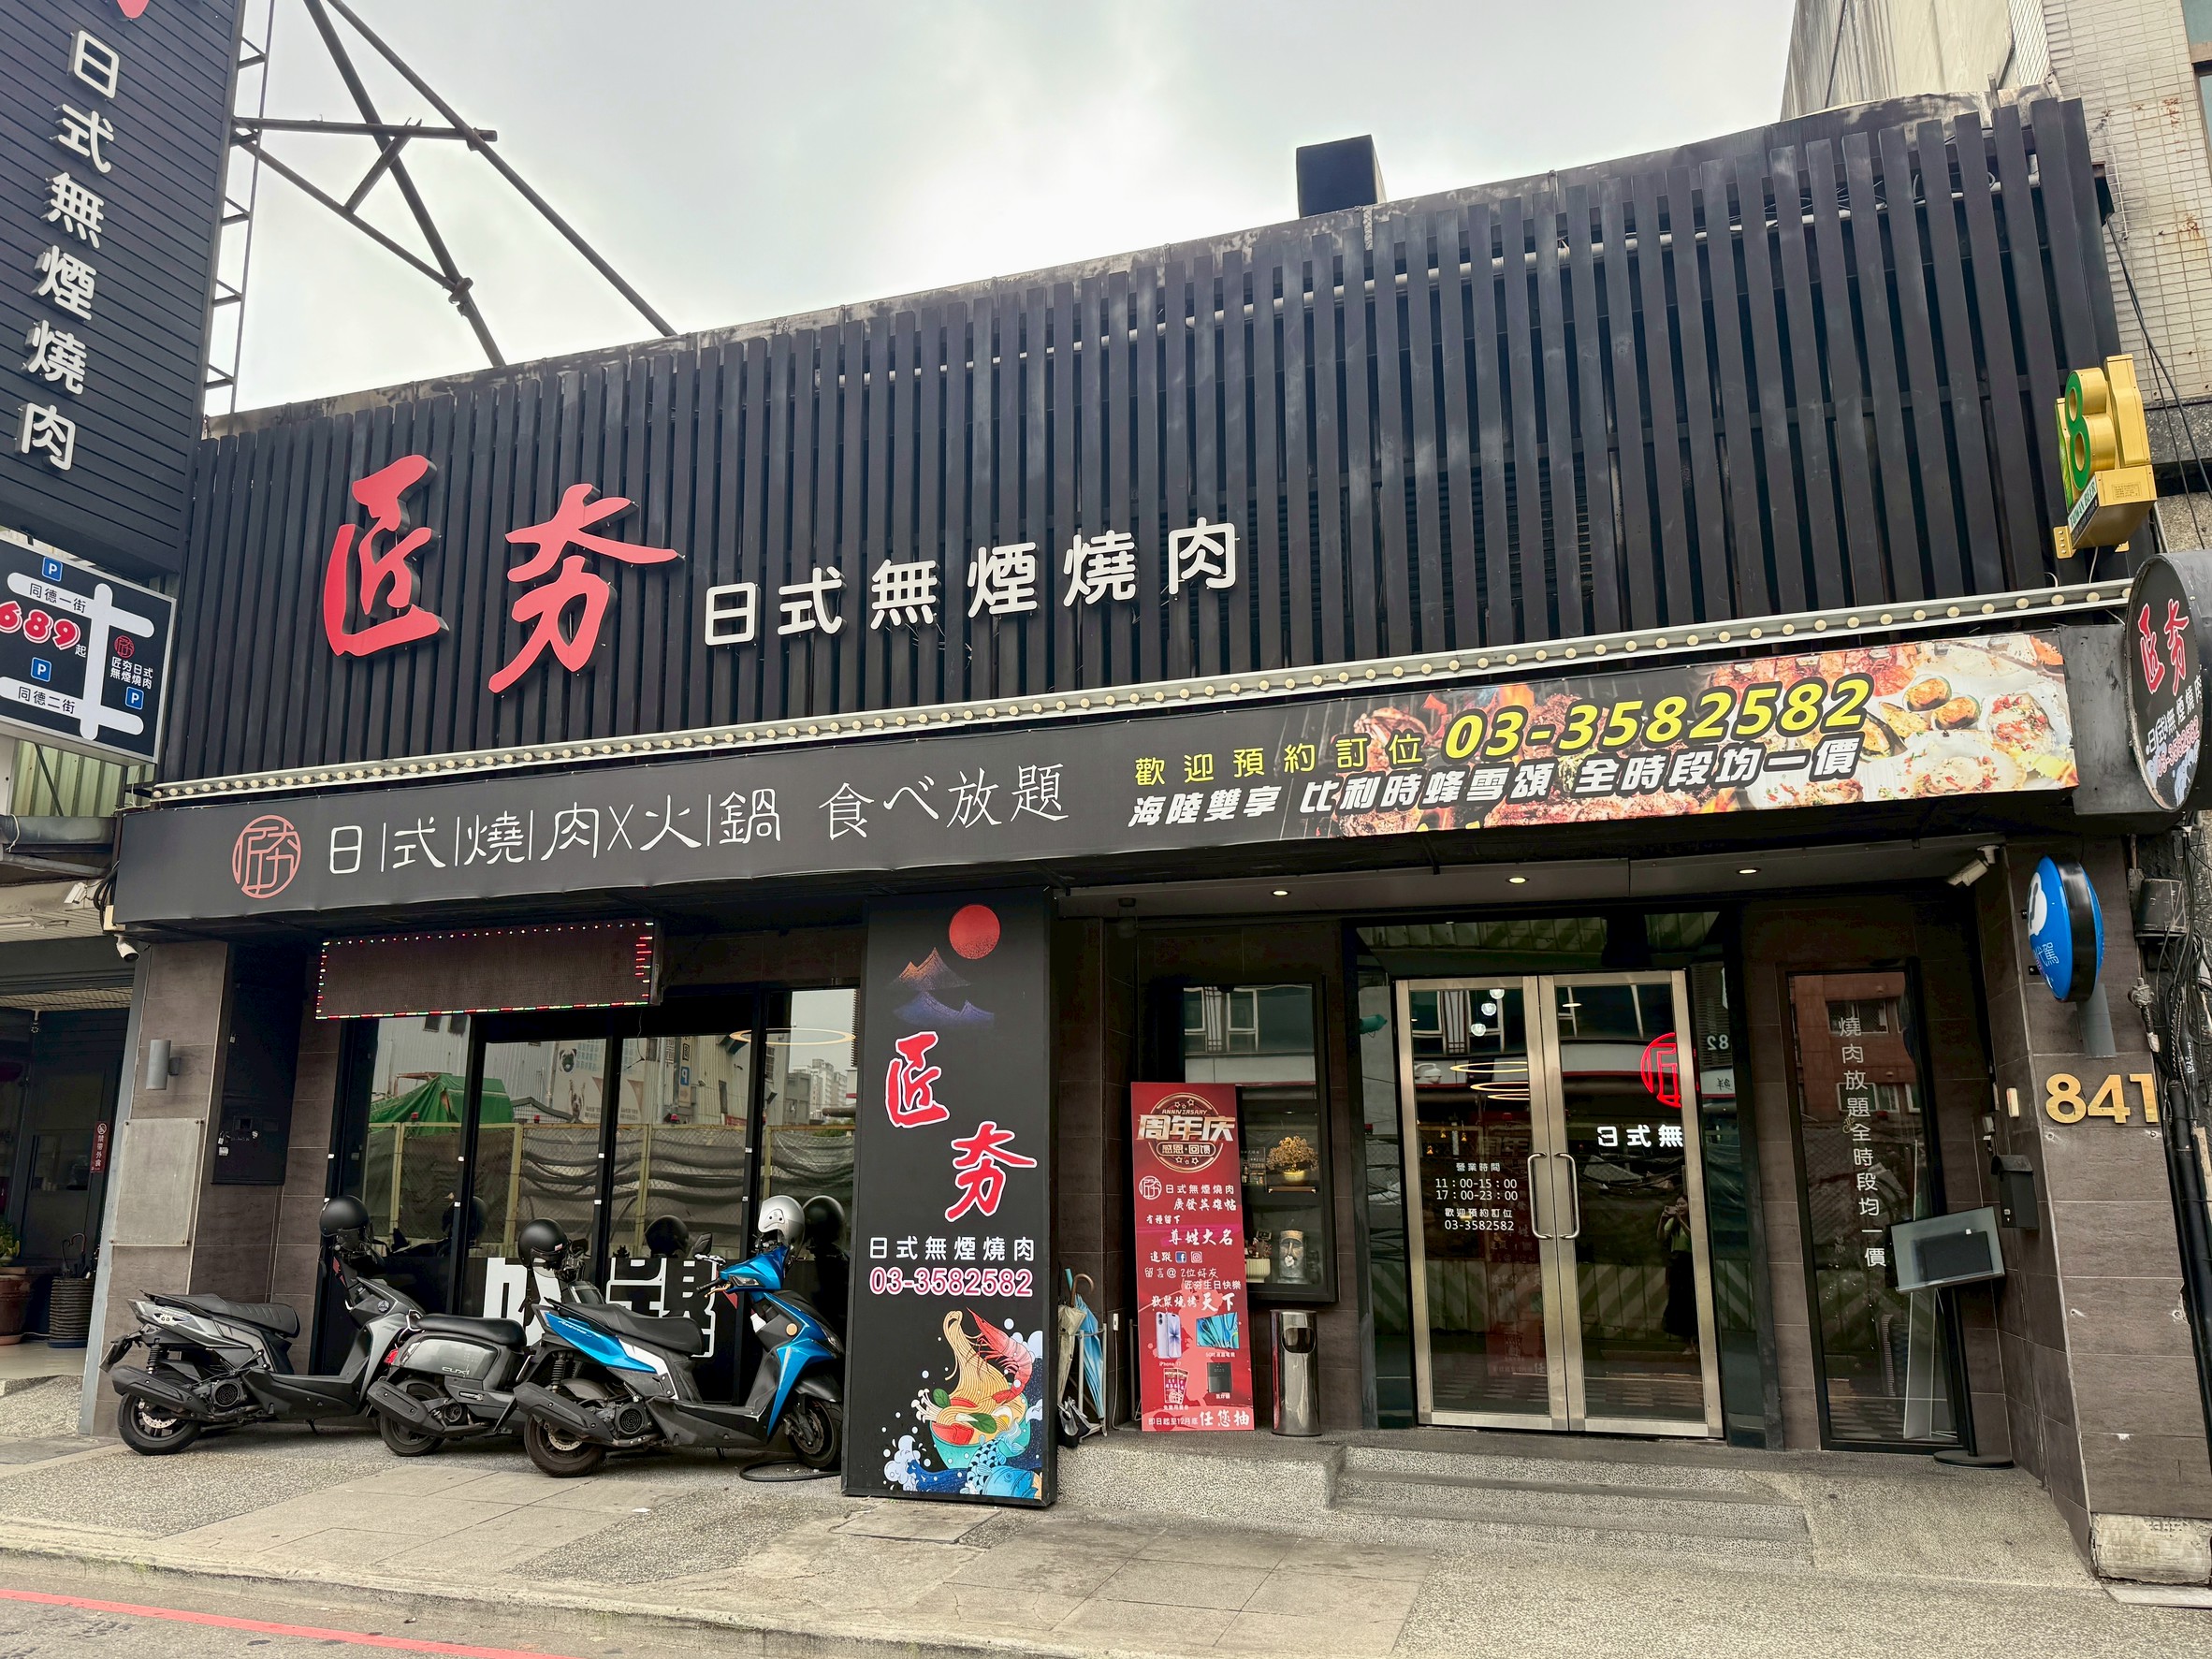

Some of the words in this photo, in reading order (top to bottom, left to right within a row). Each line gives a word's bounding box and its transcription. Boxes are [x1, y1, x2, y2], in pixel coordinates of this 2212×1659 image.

[20, 30, 120, 471] 日式無煙燒肉
[323, 454, 677, 693] 匠夯
[705, 517, 1236, 646] 日式無煙燒肉
[29, 583, 86, 613] 同德一街
[2138, 598, 2189, 695] 匠夯
[110, 667, 152, 690] 無煙燒肉
[111, 656, 153, 679] 匠夯日式
[18, 686, 76, 714] 同德二街
[1135, 733, 1423, 786] 歡迎預約訂位
[1445, 678, 1870, 759] 03-3582582
[1128, 785, 1282, 827] 海陸雙享
[1299, 762, 1555, 814] 比利時蜂雪頌
[1576, 737, 1860, 793] 全時段均一價
[818, 763, 1070, 841] 食べ放題
[2045, 1073, 2159, 1124] 841
[884, 1031, 1038, 1222] 匠夯
[1136, 1114, 1235, 1142] 周年庆
[1838, 1016, 1886, 1268] 燒肉放題全時段均一價
[1456, 1162, 1501, 1172] 營業時間
[1166, 1184, 1235, 1195] 日式無煙燒肉
[1173, 1198, 1237, 1211] 廣發英雄帖
[1168, 1228, 1234, 1245] 尊姓大名
[1444, 1219, 1515, 1231] 03-3582582
[869, 1236, 1035, 1262] 日式無煙燒肉
[869, 1266, 1034, 1297] 03-3582582
[1184, 1280, 1242, 1290] 匠夯生日快樂
[1200, 1409, 1250, 1428] 任您抽
